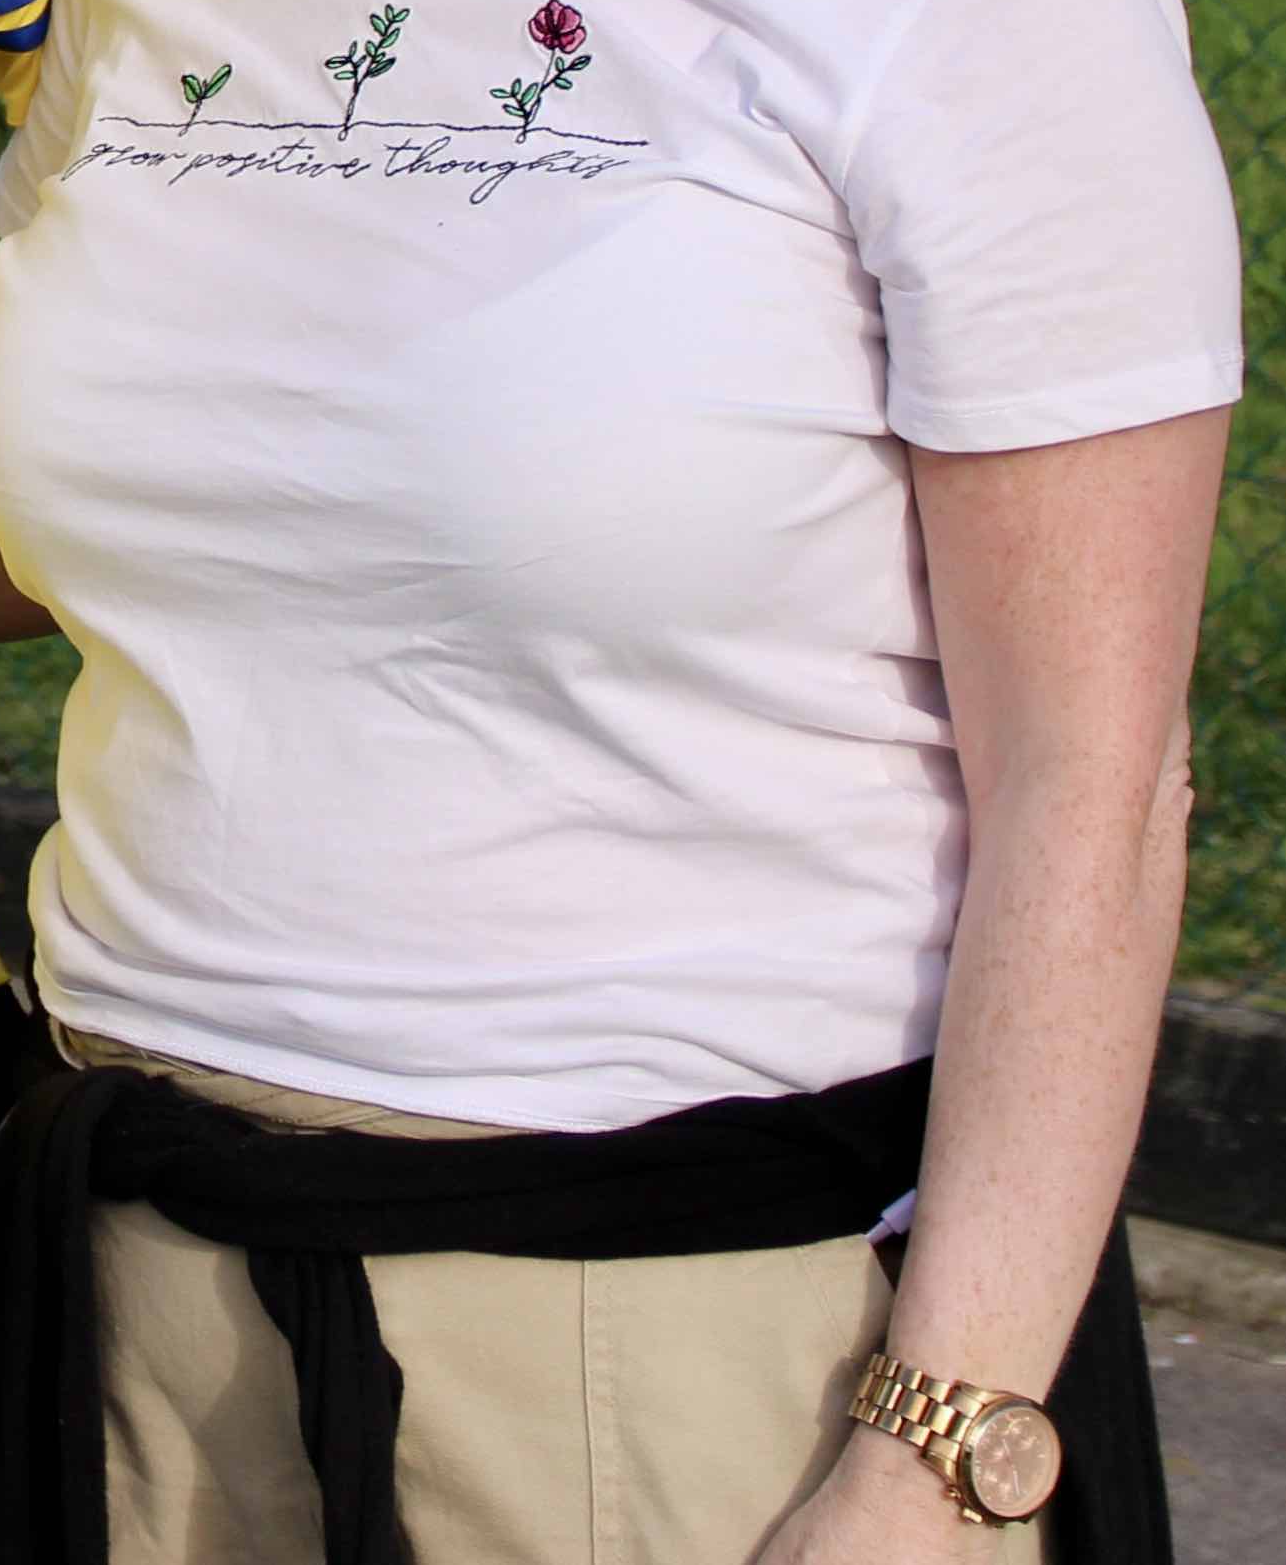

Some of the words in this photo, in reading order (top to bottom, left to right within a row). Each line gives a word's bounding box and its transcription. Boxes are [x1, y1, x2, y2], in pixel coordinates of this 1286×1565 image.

[60, 142, 186, 181] grow
[167, 137, 372, 186] positive
[383, 135, 631, 205] thoughts
